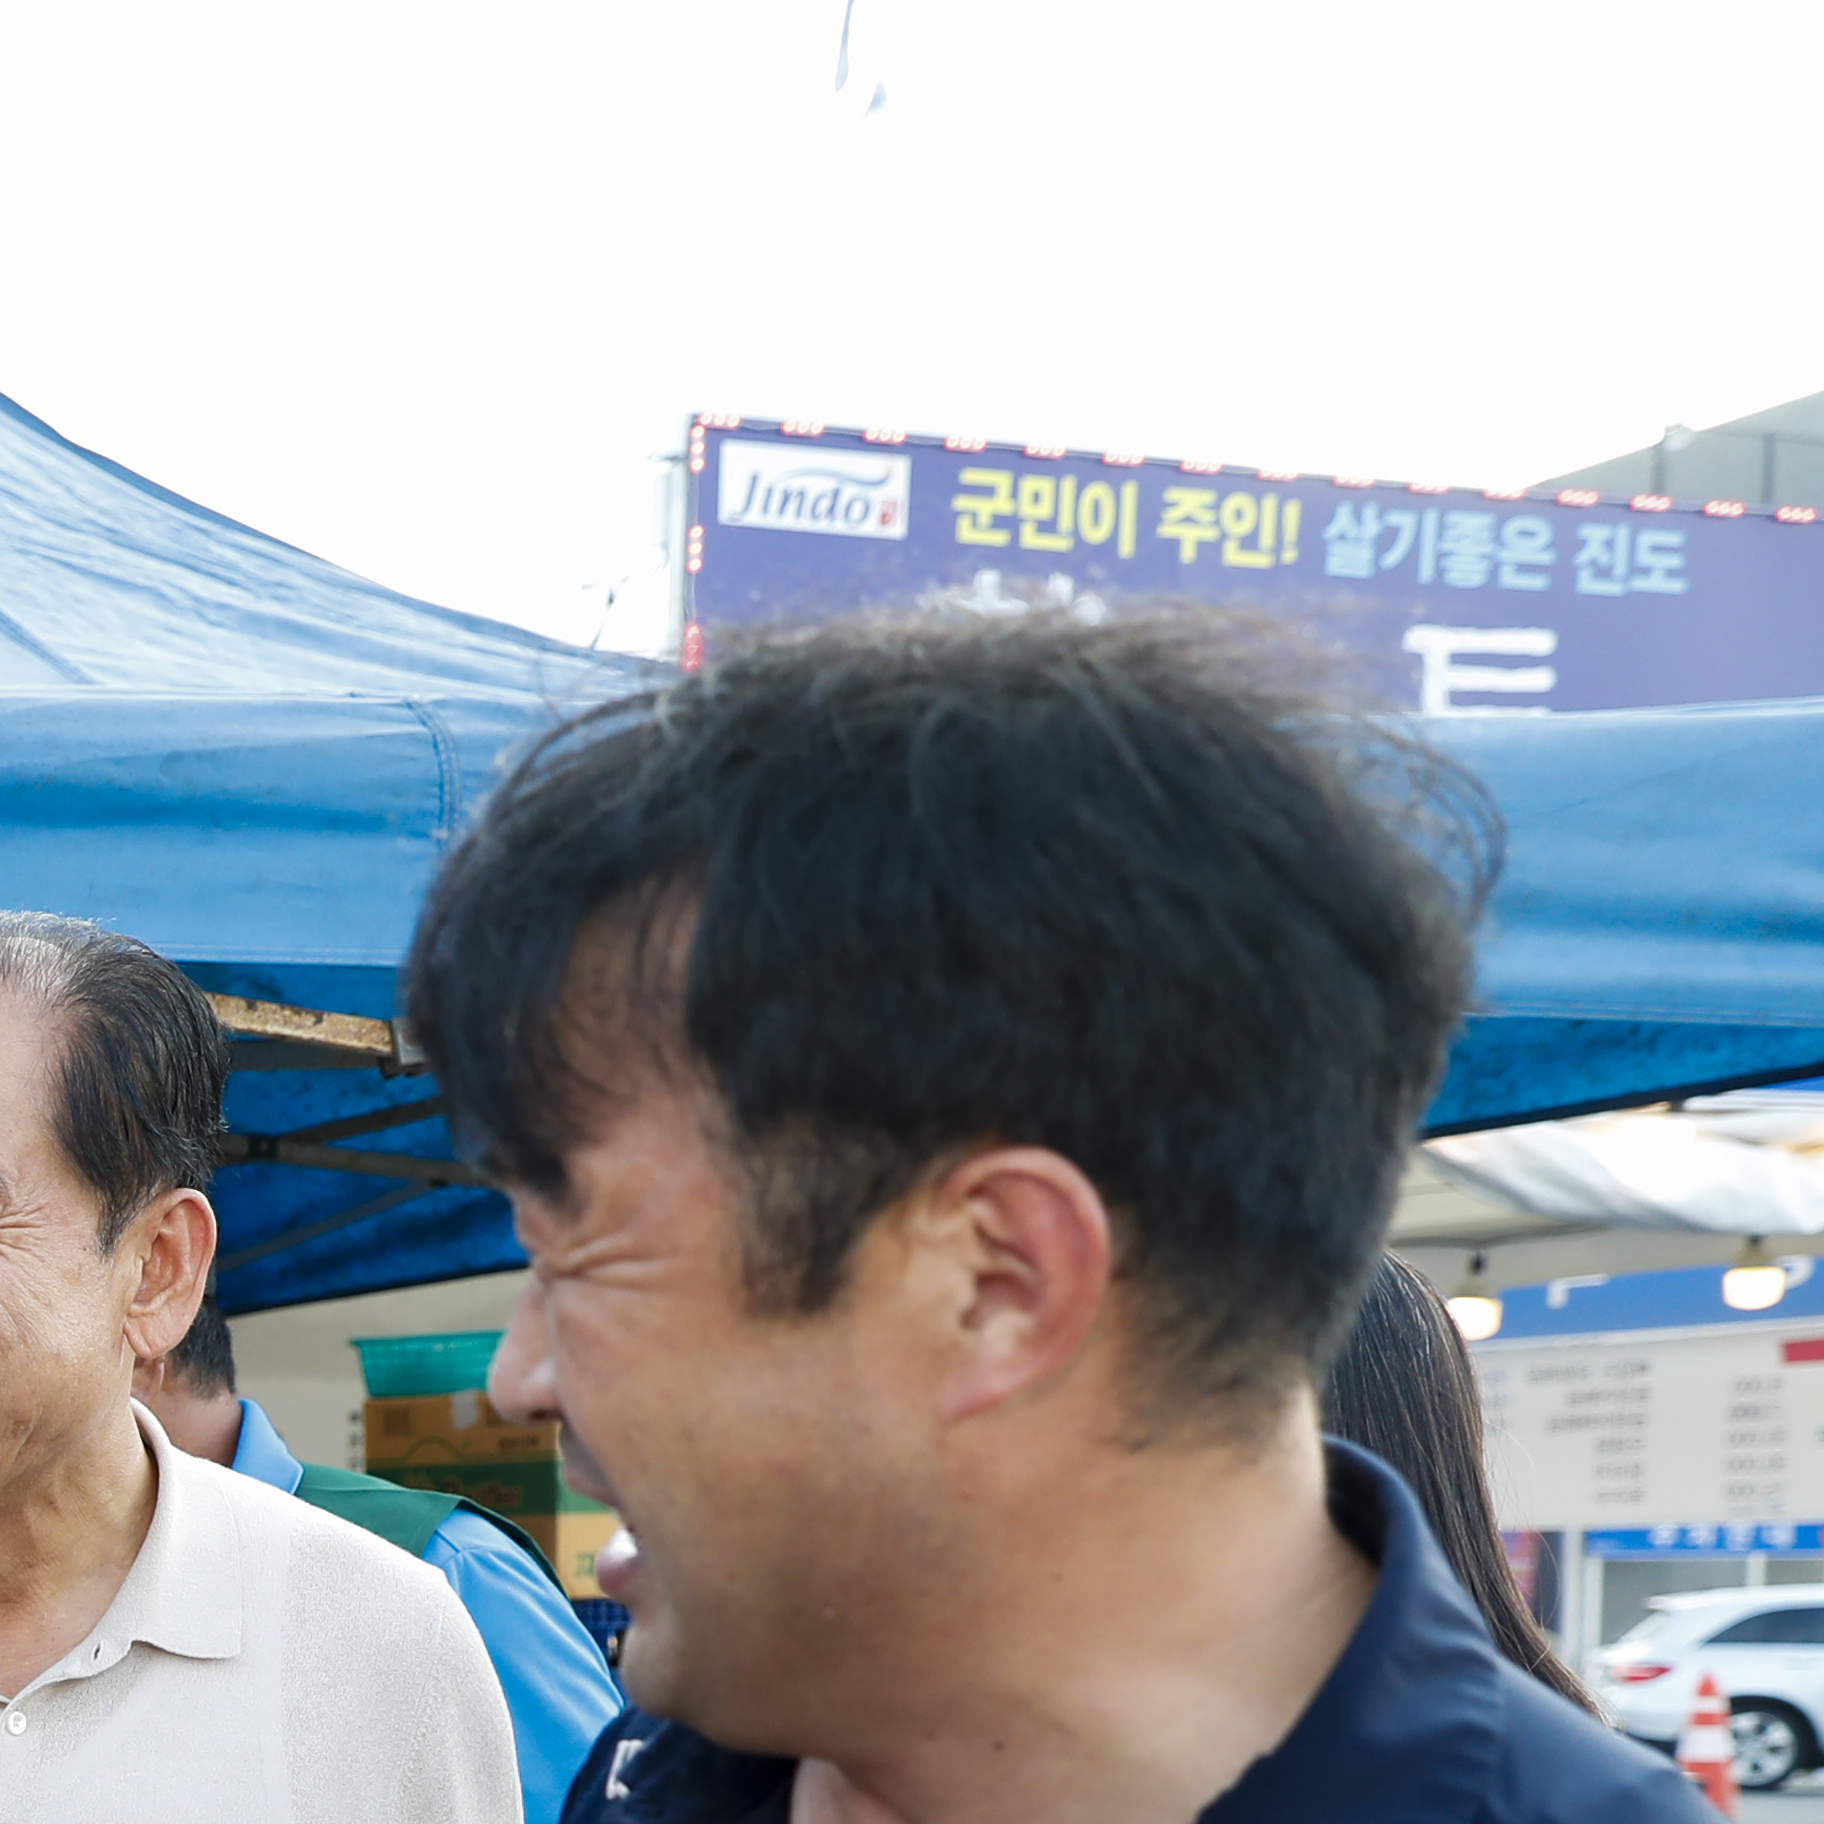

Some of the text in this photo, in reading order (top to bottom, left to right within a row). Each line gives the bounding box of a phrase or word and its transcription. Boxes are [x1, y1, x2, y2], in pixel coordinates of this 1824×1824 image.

[725, 470, 873, 528] Jindo
[952, 466, 1690, 596] 군민이 주인! 살기좋은 진도
